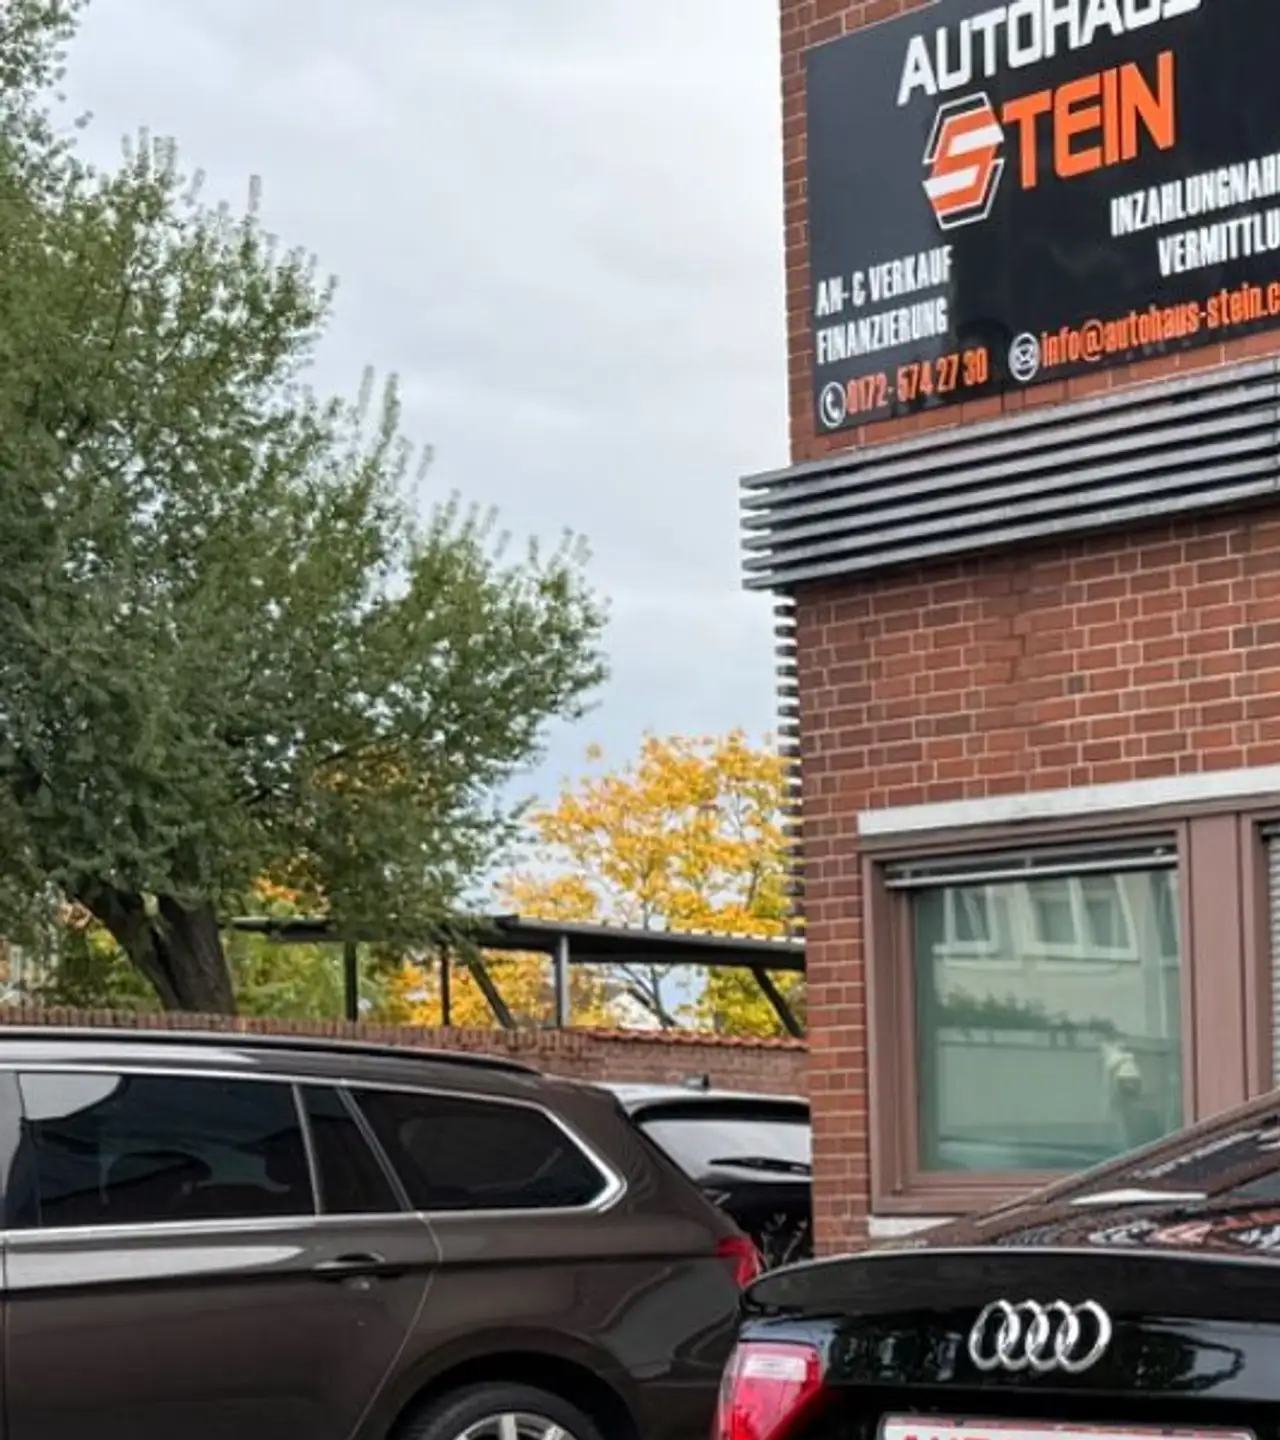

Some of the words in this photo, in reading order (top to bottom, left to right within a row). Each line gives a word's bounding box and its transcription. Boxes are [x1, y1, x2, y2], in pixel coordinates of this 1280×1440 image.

[922, 50, 1175, 222] STEIN
[868, 244, 953, 302] VERKAUF
[816, 297, 948, 365] FINANZIERUNG
[935, 352, 959, 392] 27
